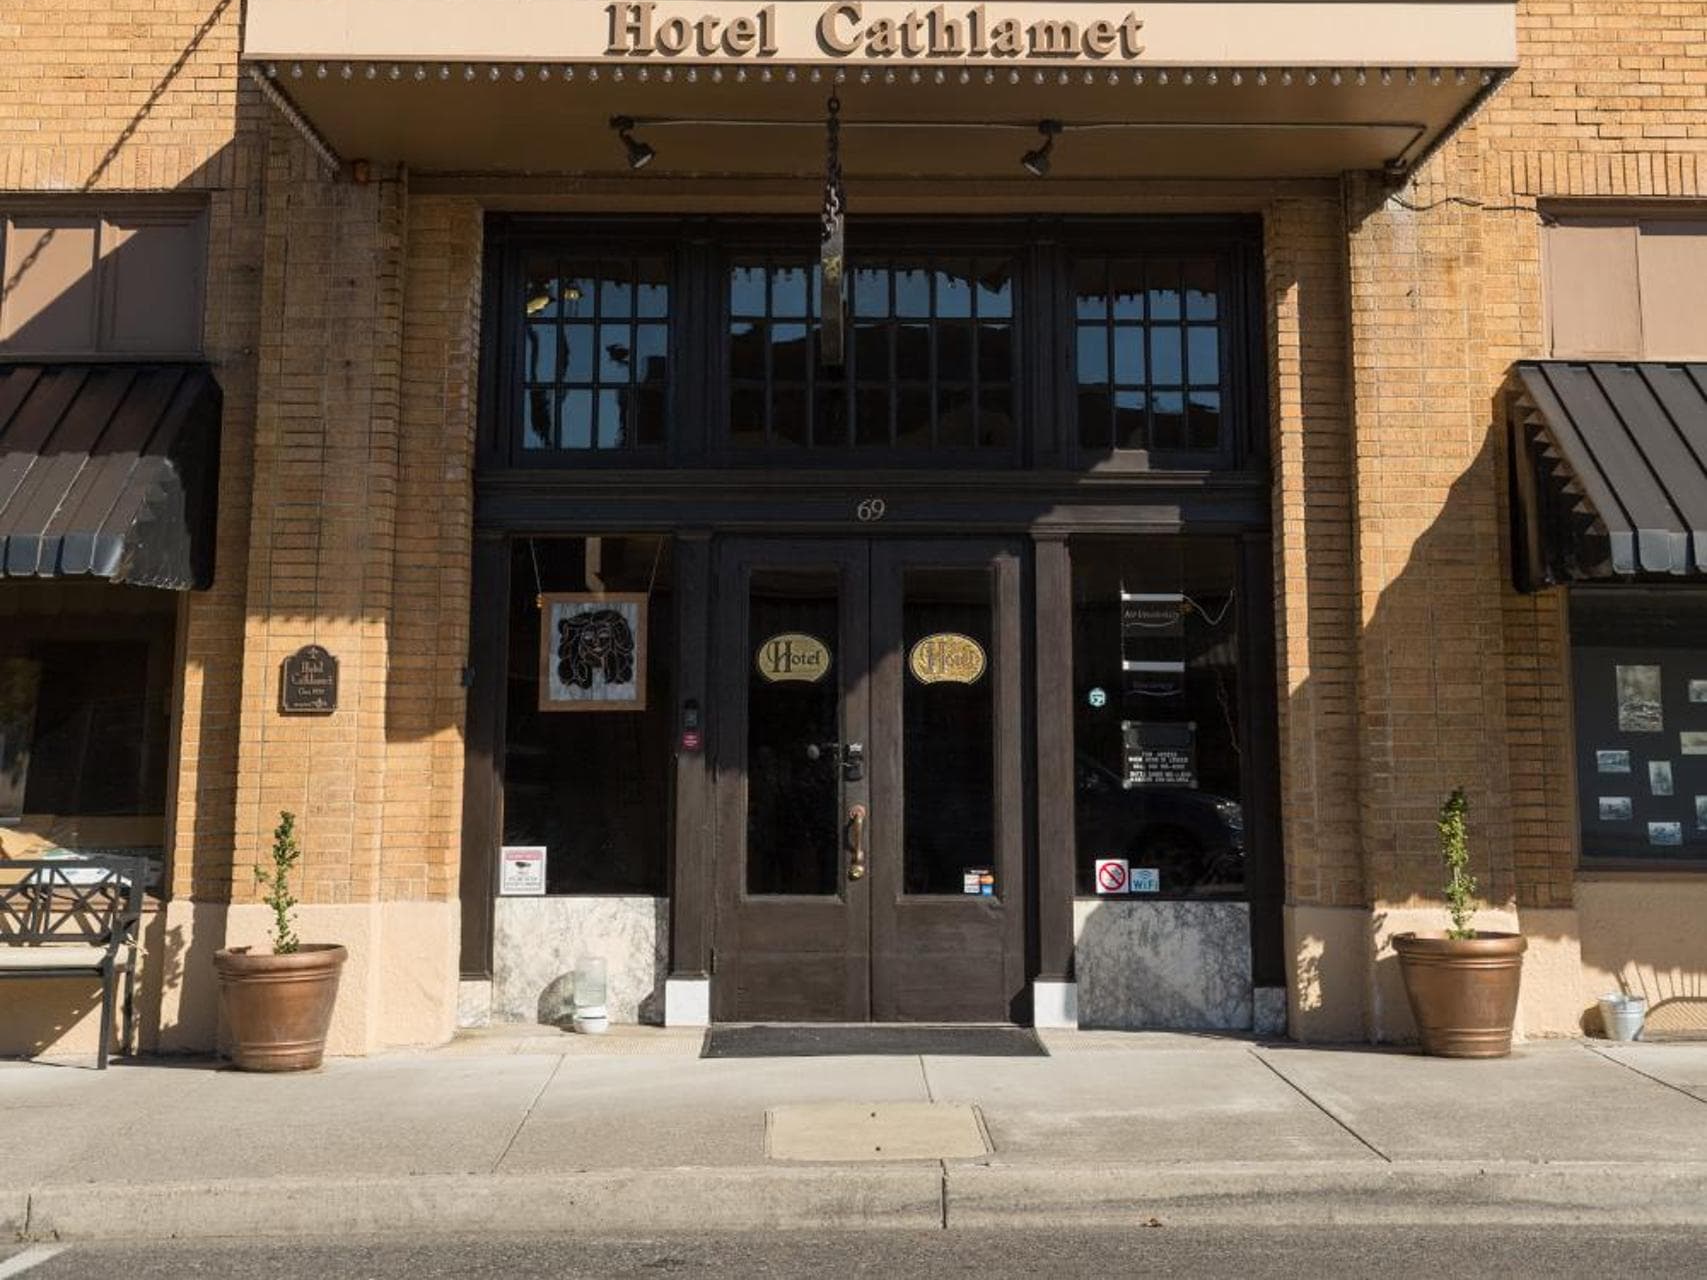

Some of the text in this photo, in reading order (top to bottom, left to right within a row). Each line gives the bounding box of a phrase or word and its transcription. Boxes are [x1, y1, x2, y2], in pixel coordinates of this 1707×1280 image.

[604, 1, 1145, 58] Hotel Cathlamet
[857, 499, 886, 521] 69
[767, 641, 822, 673] Hotel
